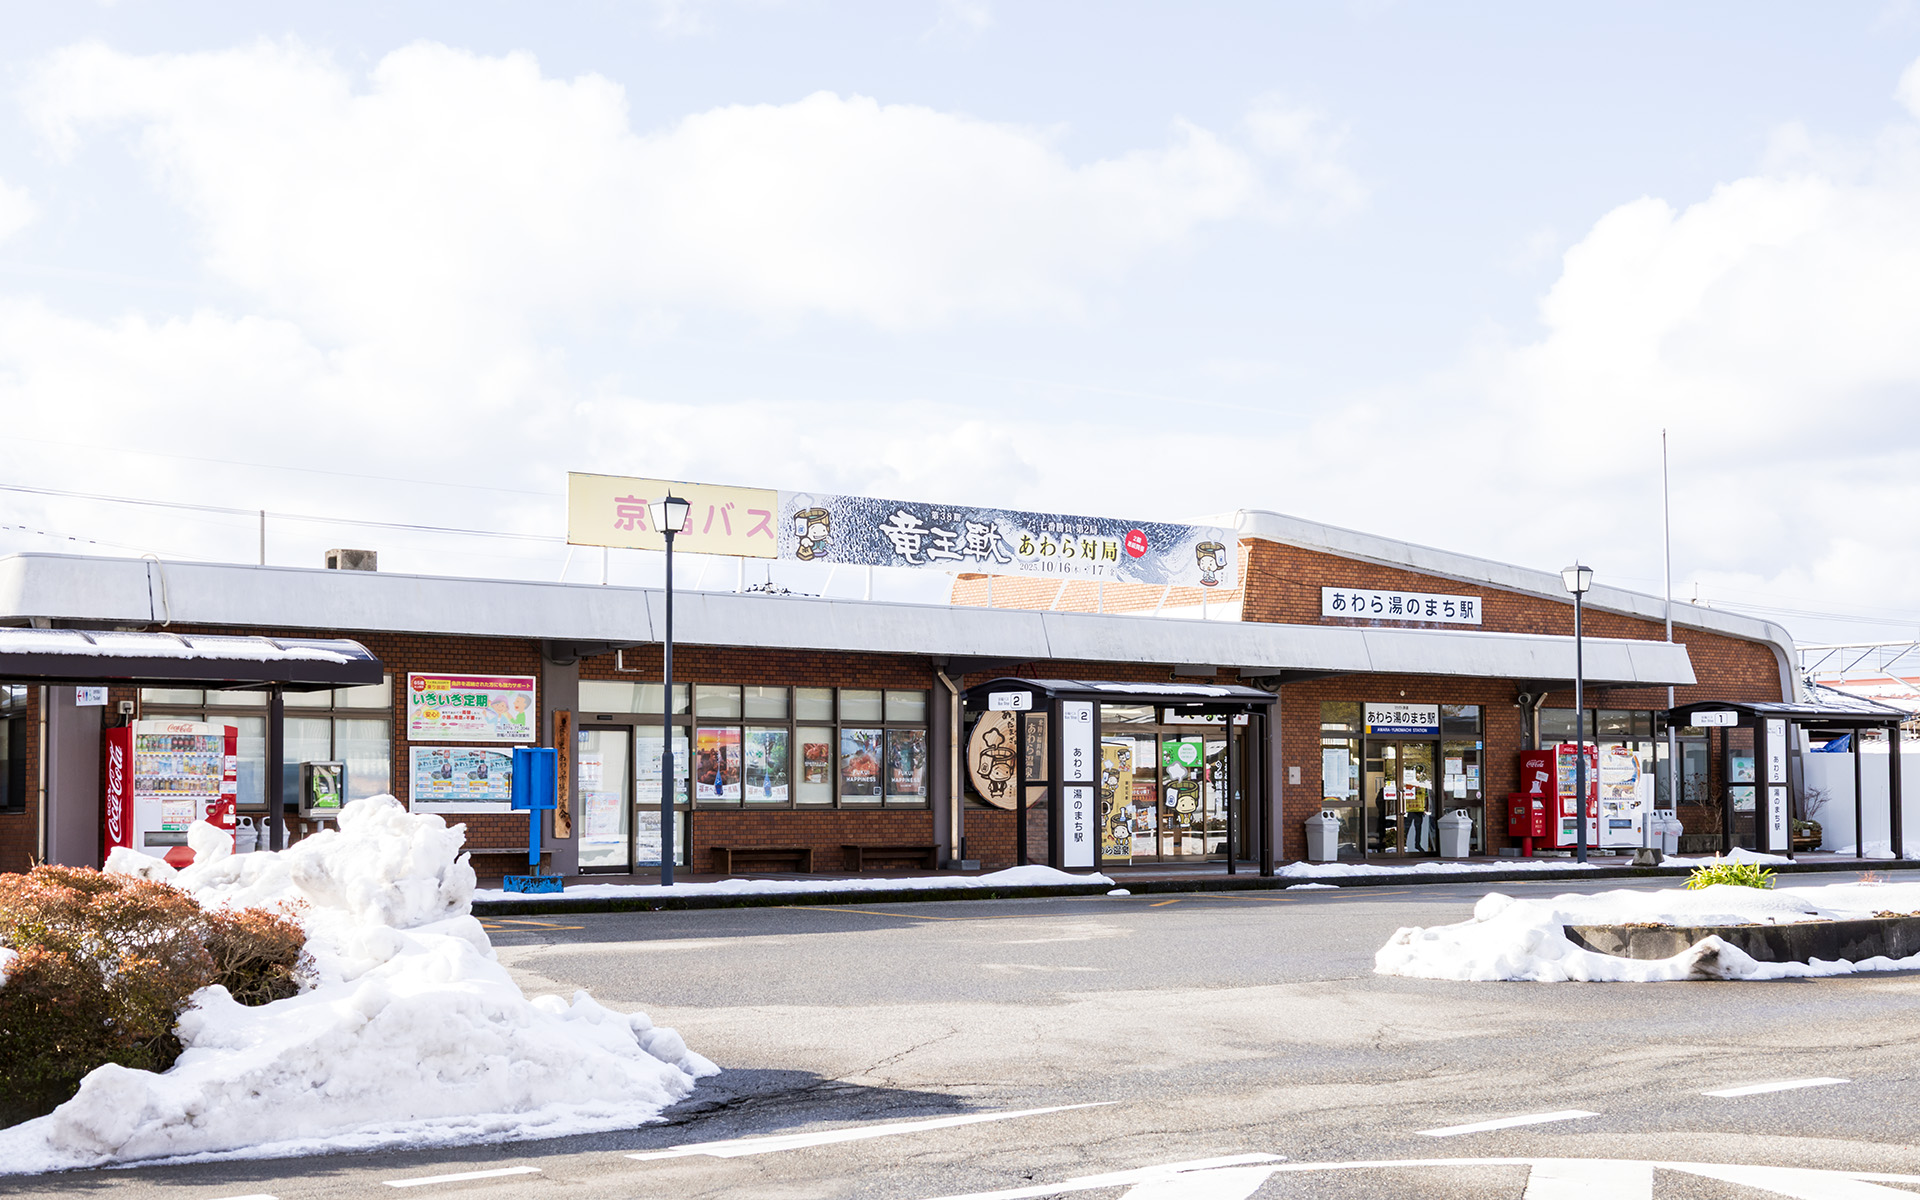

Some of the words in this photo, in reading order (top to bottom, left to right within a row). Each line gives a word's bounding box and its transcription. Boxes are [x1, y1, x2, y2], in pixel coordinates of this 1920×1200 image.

[613, 494, 775, 540] 京バス
[931, 511, 962, 522] 第38期
[1040, 522, 1072, 535] 七番勝負
[1076, 524, 1098, 536] 第2局
[1018, 534, 1118, 563] あわら対局
[1331, 592, 1475, 620] あわら湯のまち駅
[412, 692, 489, 708] いきいき定期
[1013, 696, 1020, 706] 2
[1081, 711, 1088, 721] 2
[1367, 711, 1436, 724] あわら湯のまち駅
[1719, 714, 1724, 723] 1
[166, 723, 193, 733] Coca-Cola
[1778, 727, 1782, 735] 1
[108, 739, 123, 844] Coca-Cola
